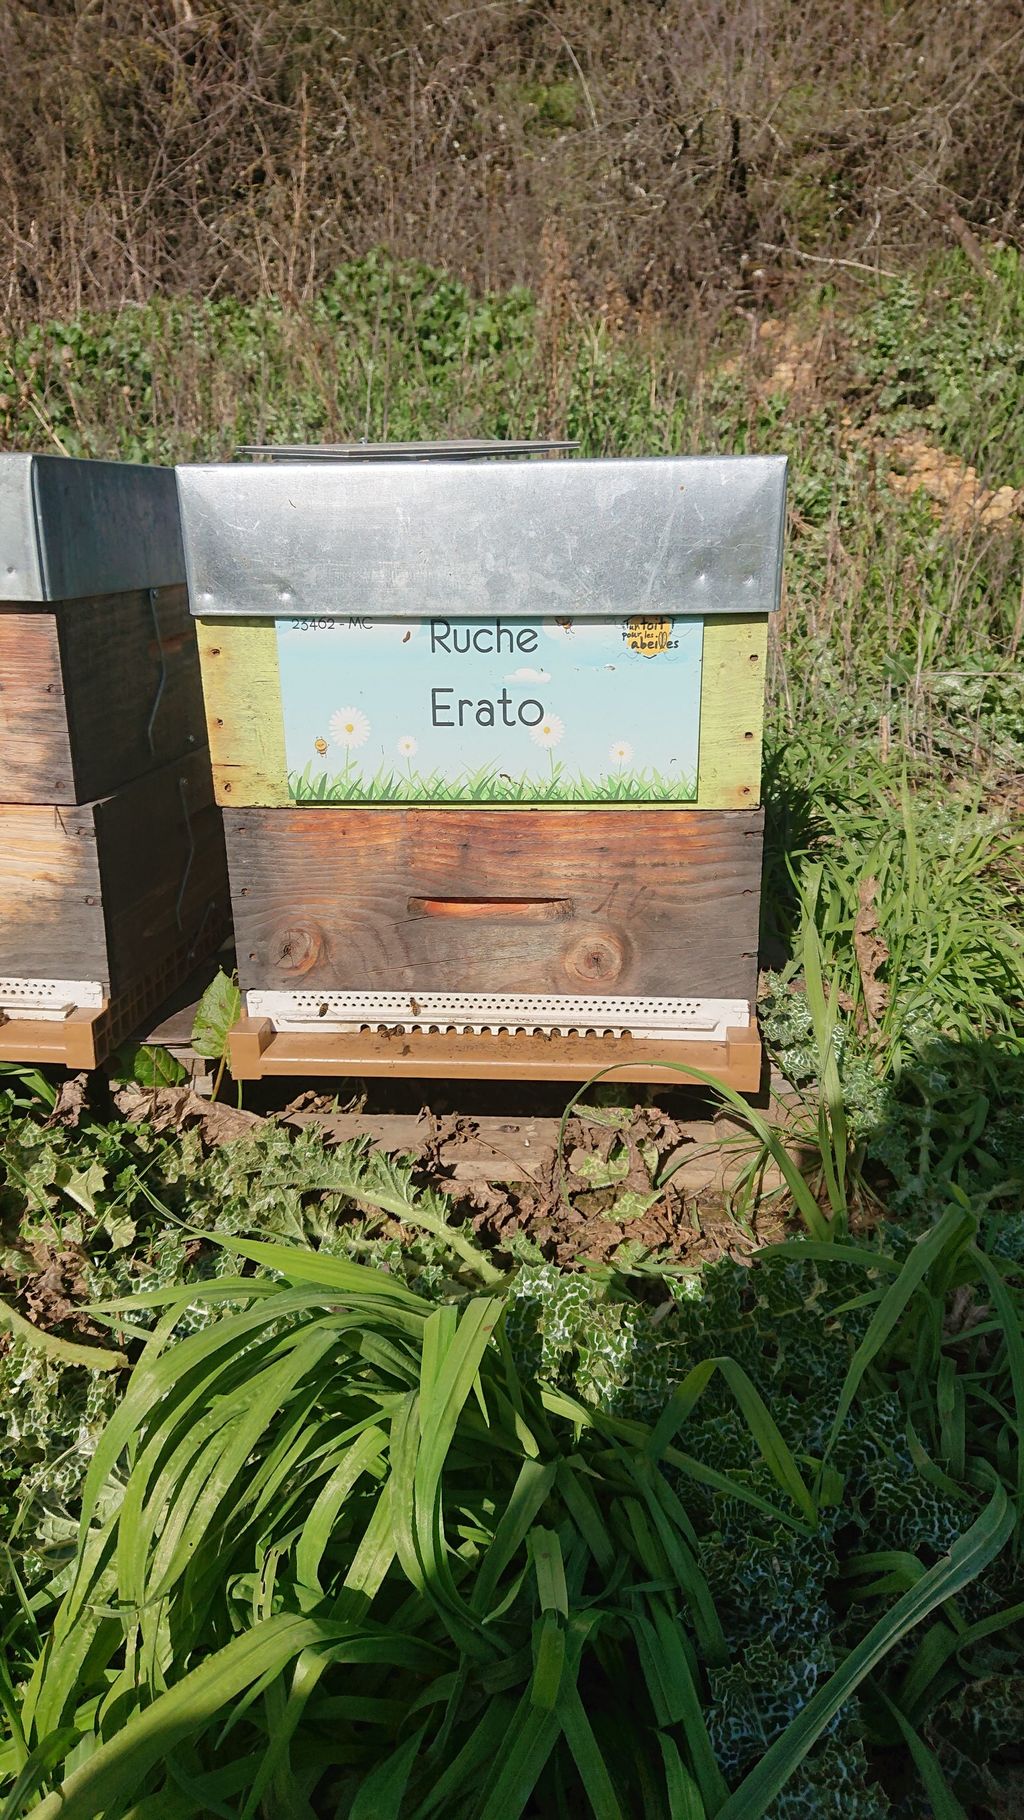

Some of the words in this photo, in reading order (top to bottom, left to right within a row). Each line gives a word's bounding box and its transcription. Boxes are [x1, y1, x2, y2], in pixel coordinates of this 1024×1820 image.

[291, 616, 336, 631] 23462
[348, 616, 373, 630] MC
[430, 617, 538, 654] Ruche
[621, 632, 642, 641] pour
[644, 631, 655, 639] les
[631, 631, 680, 650] abeilles
[431, 687, 545, 727] Erato
